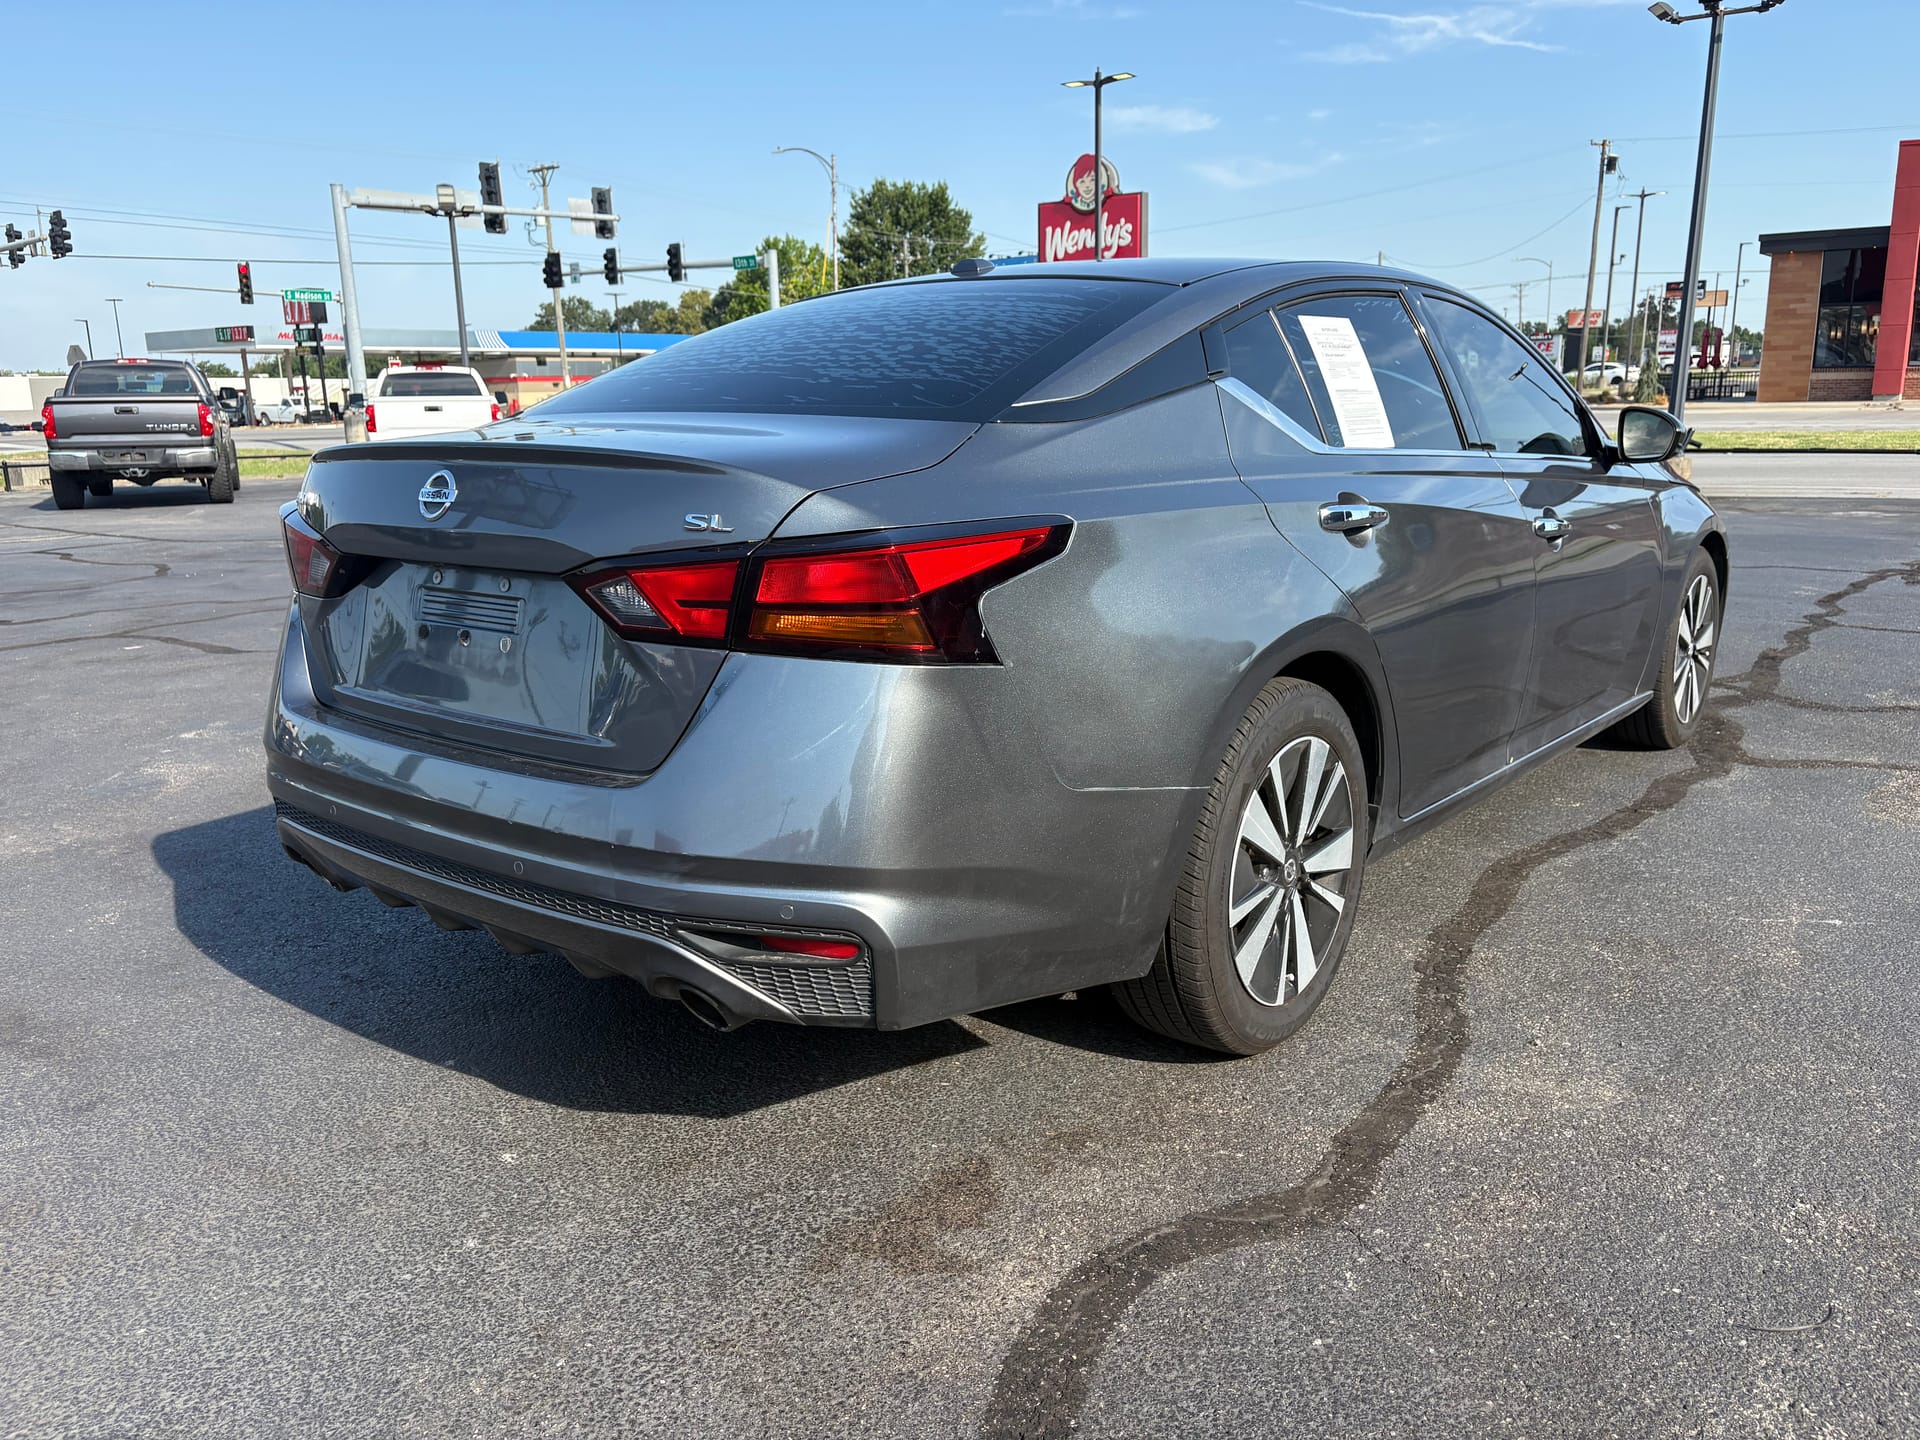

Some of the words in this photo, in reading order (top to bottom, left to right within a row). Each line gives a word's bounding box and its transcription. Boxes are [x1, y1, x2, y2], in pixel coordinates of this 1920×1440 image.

[1045, 211, 1133, 261] Wendy's
[295, 291, 322, 300] Madison
[145, 423, 197, 431] TUNDRA
[683, 513, 736, 533] SL
